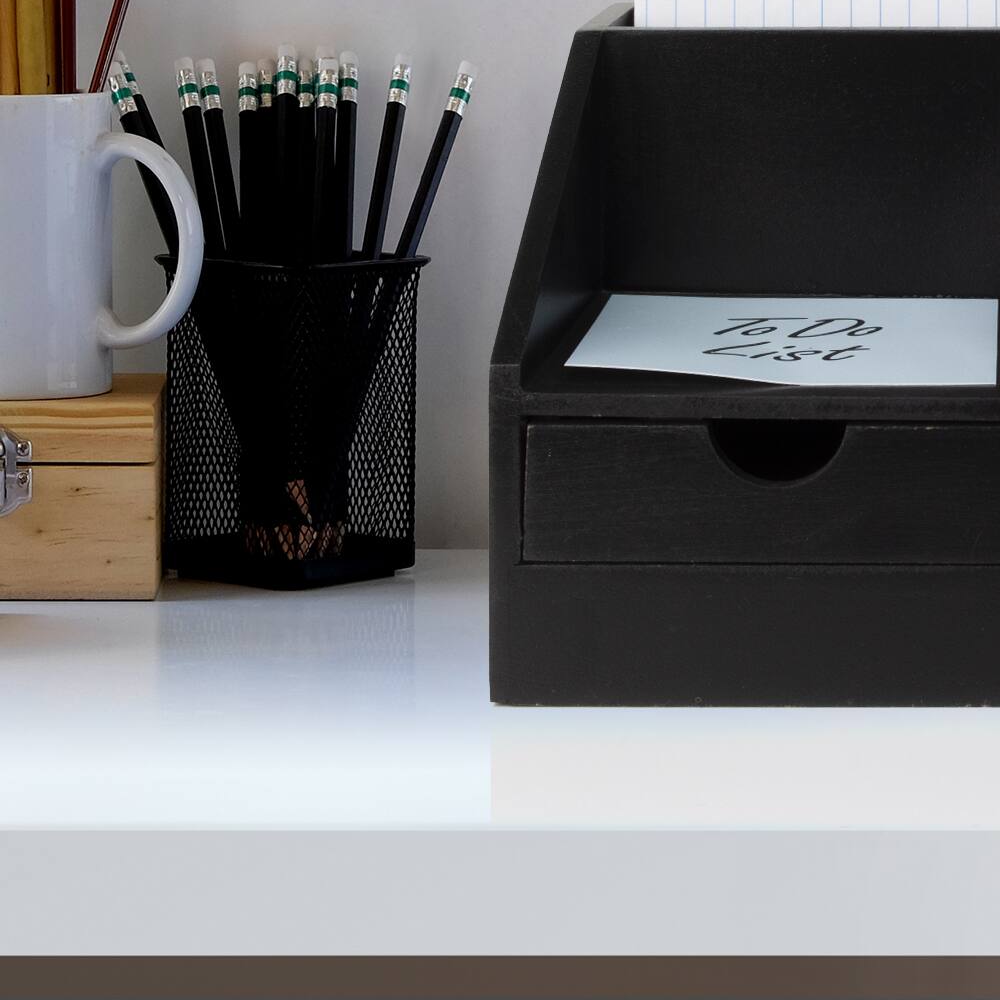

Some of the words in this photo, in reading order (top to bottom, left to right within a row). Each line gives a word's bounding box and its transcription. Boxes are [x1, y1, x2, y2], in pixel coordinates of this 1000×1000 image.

[713, 318, 808, 335] To
[787, 318, 883, 338] Do
[702, 341, 870, 361] List
